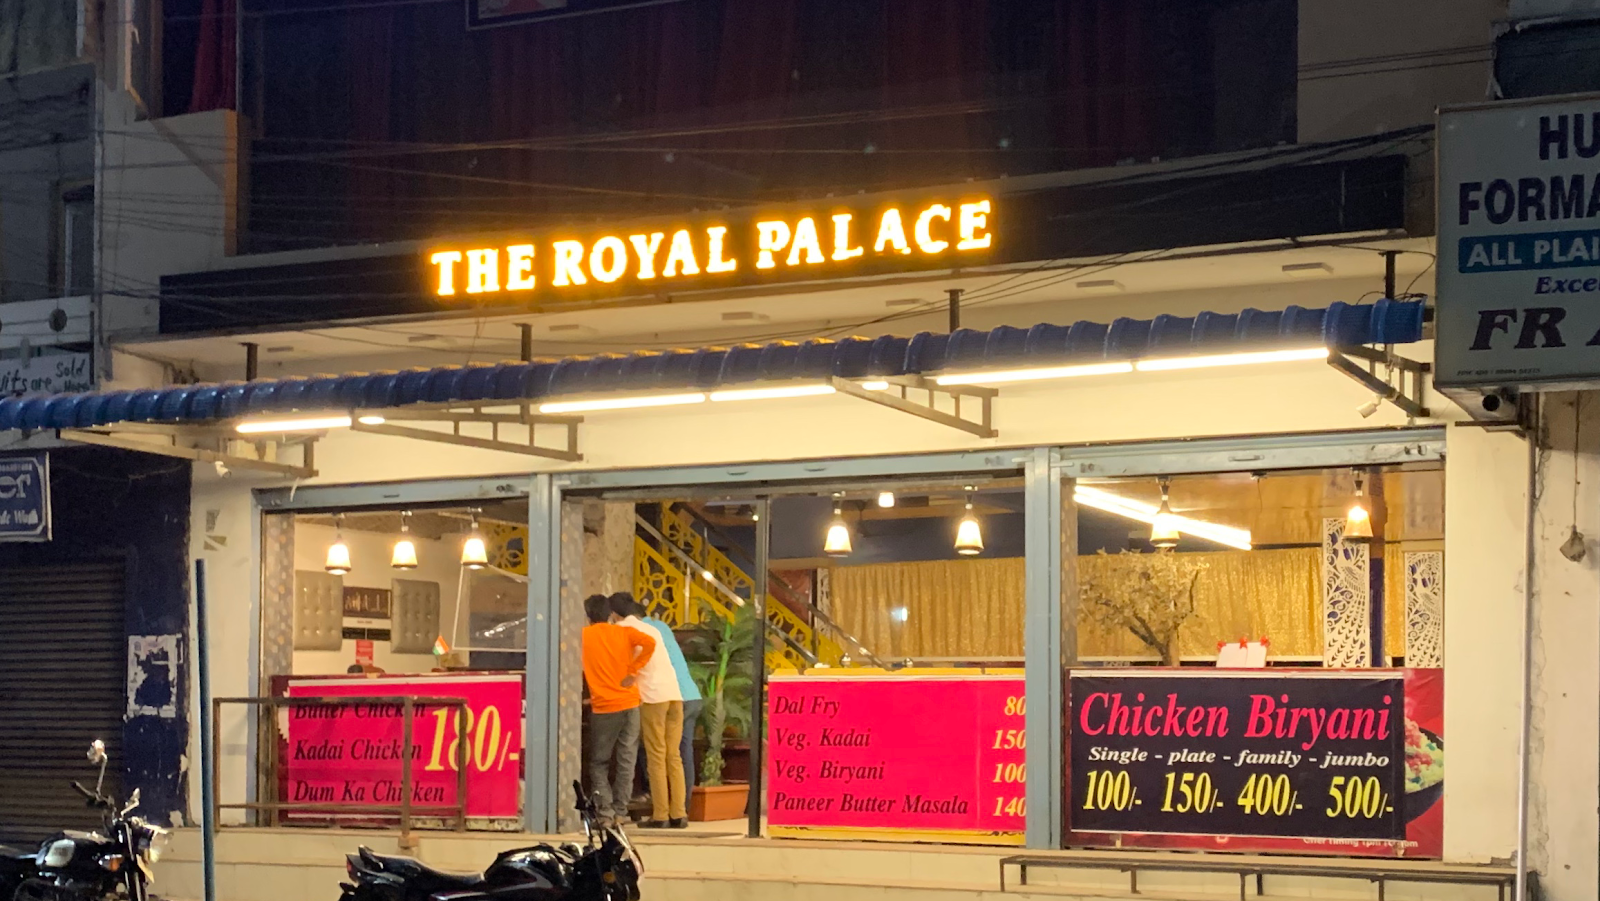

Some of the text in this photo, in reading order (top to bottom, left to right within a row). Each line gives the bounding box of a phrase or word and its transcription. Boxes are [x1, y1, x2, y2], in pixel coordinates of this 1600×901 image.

[1539, 112, 1600, 160] HU
[430, 199, 993, 296] THE ROYAL PALACE
[1466, 236, 1600, 268] ALL PLAI
[1534, 275, 1600, 294] Exce
[1469, 307, 1567, 351] FR
[56, 357, 86, 378] Sold
[354, 702, 426, 719] Chickn
[773, 696, 1026, 718] Dal Fry 80
[1080, 692, 1391, 751] Chicken Biryani
[294, 738, 422, 760] Kadai Chickn
[425, 705, 519, 772] 180/-
[775, 728, 1026, 750] Veg. Kadai 150
[1088, 746, 1148, 764] Single
[1168, 748, 1216, 766] plate
[1234, 749, 1302, 768] family
[1319, 751, 1390, 769] jumbo
[775, 760, 1026, 784] Veg. Biryani 100
[294, 780, 444, 802] Dum Ka Chiken
[1083, 770, 1394, 819] 100/- 150/- 400/- 500/-
[773, 792, 1026, 816] Paneer Butter Masala 140
